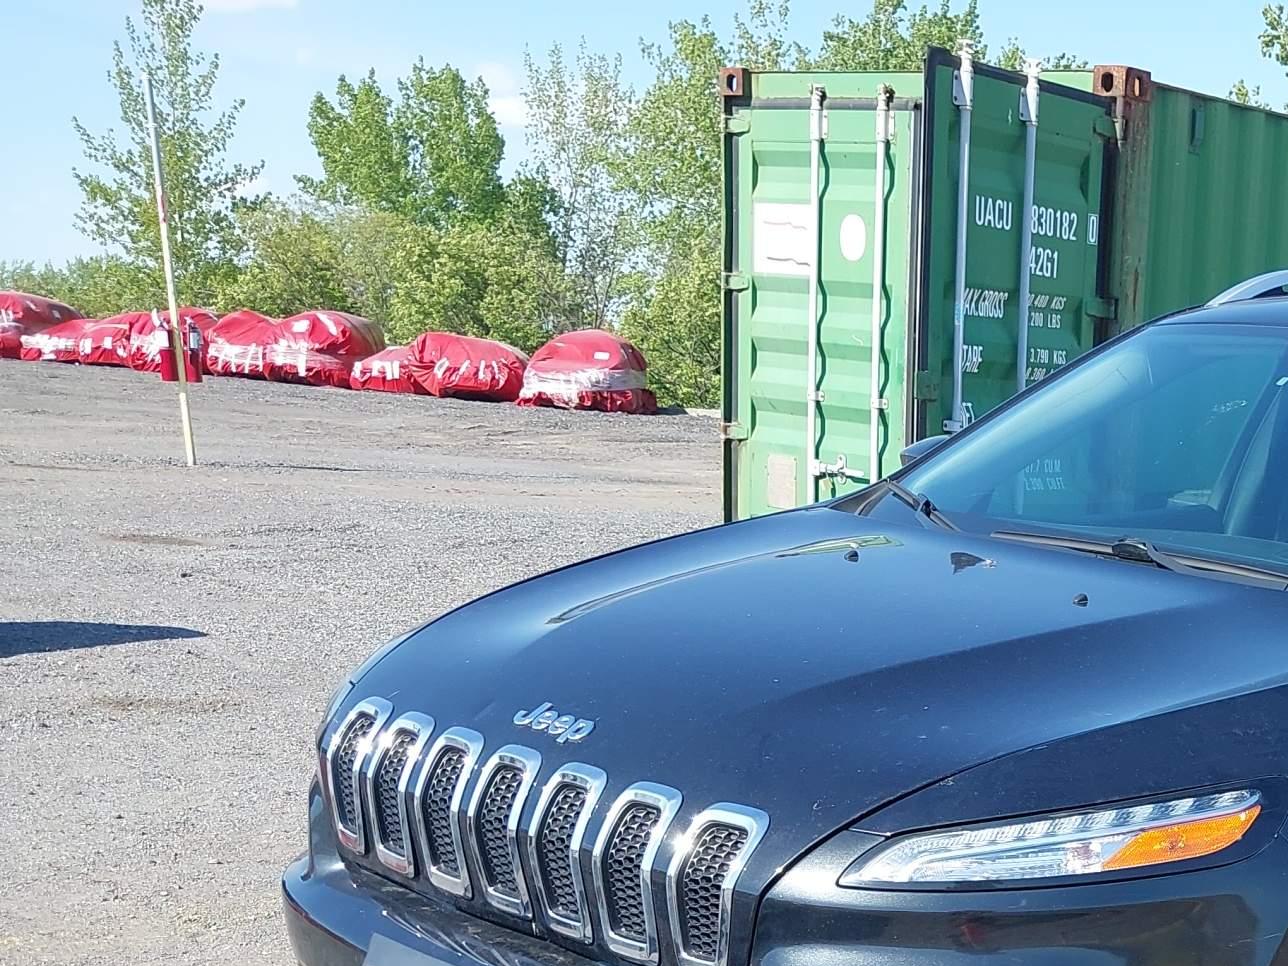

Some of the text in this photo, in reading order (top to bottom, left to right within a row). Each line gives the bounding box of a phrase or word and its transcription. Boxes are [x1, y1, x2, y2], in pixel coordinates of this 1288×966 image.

[975, 195, 1098, 243] UACU 830182 0
[1030, 246, 1058, 279] 42G1
[1050, 296, 1067, 310] KGS
[1048, 313, 1062, 329] LBS
[962, 345, 1067, 373] TARE 3.790 KGS
[513, 702, 594, 744] Jeep
